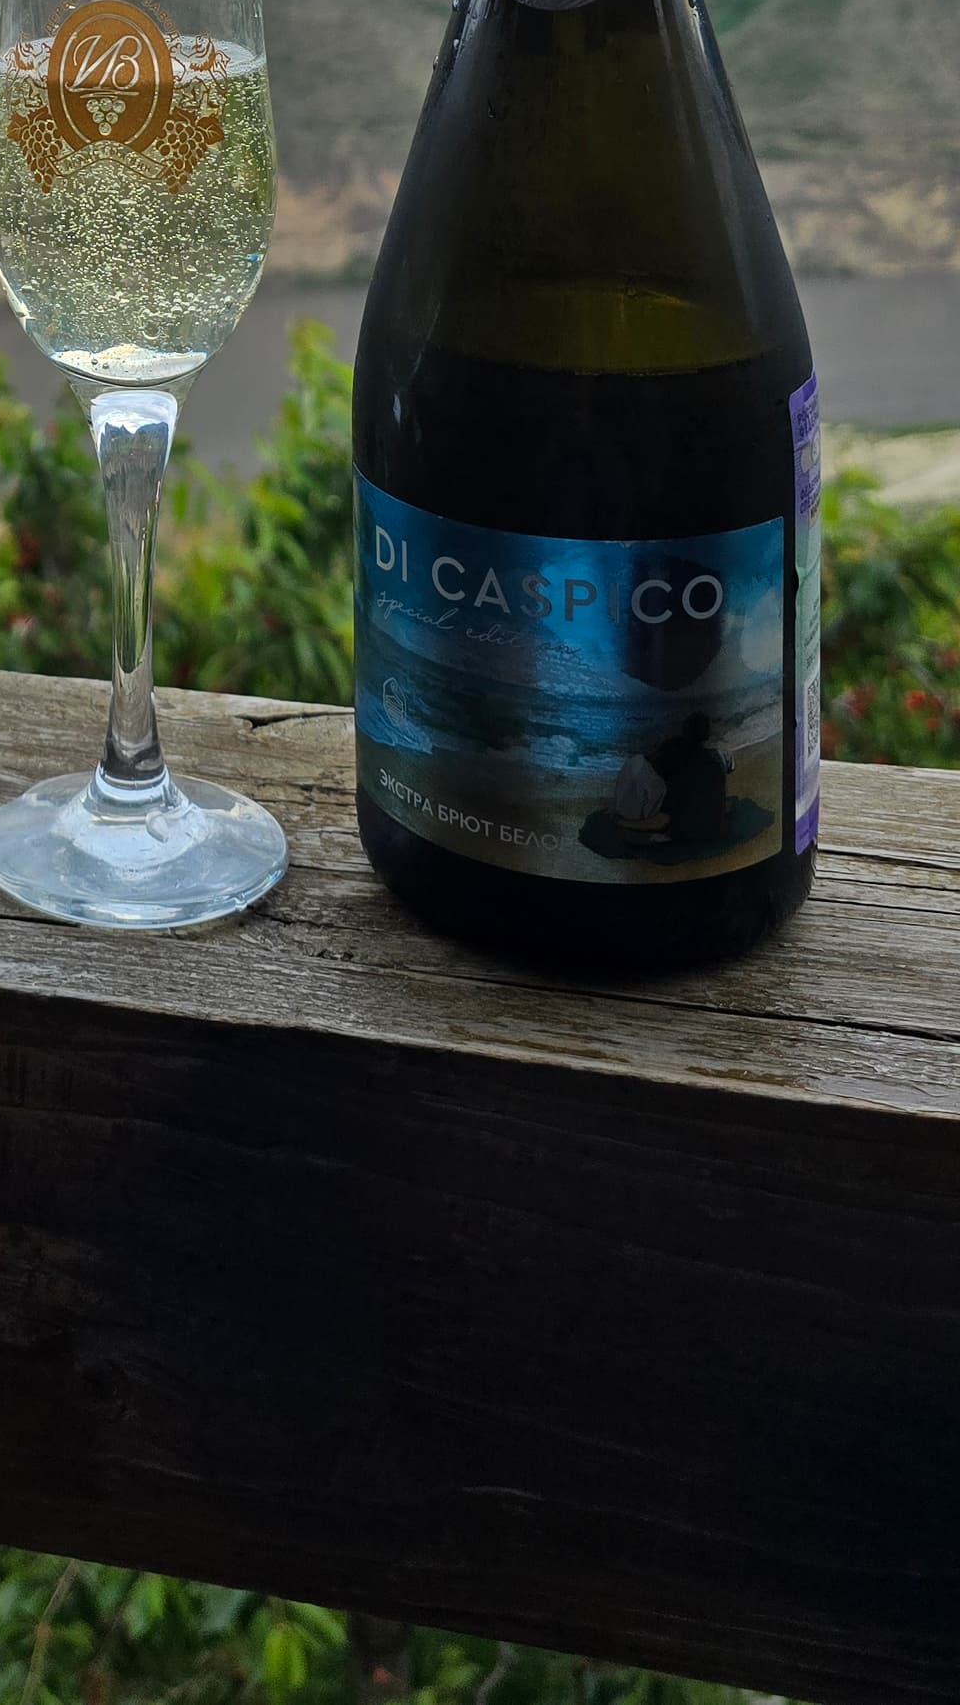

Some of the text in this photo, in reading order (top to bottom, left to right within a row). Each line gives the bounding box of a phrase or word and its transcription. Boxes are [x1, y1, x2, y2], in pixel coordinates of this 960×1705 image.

[375, 525, 723, 625] DI CASPICO
[466, 623, 582, 655] editon
[380, 768, 434, 816] ЭКСТРА
[438, 803, 494, 837] БРЮТ
